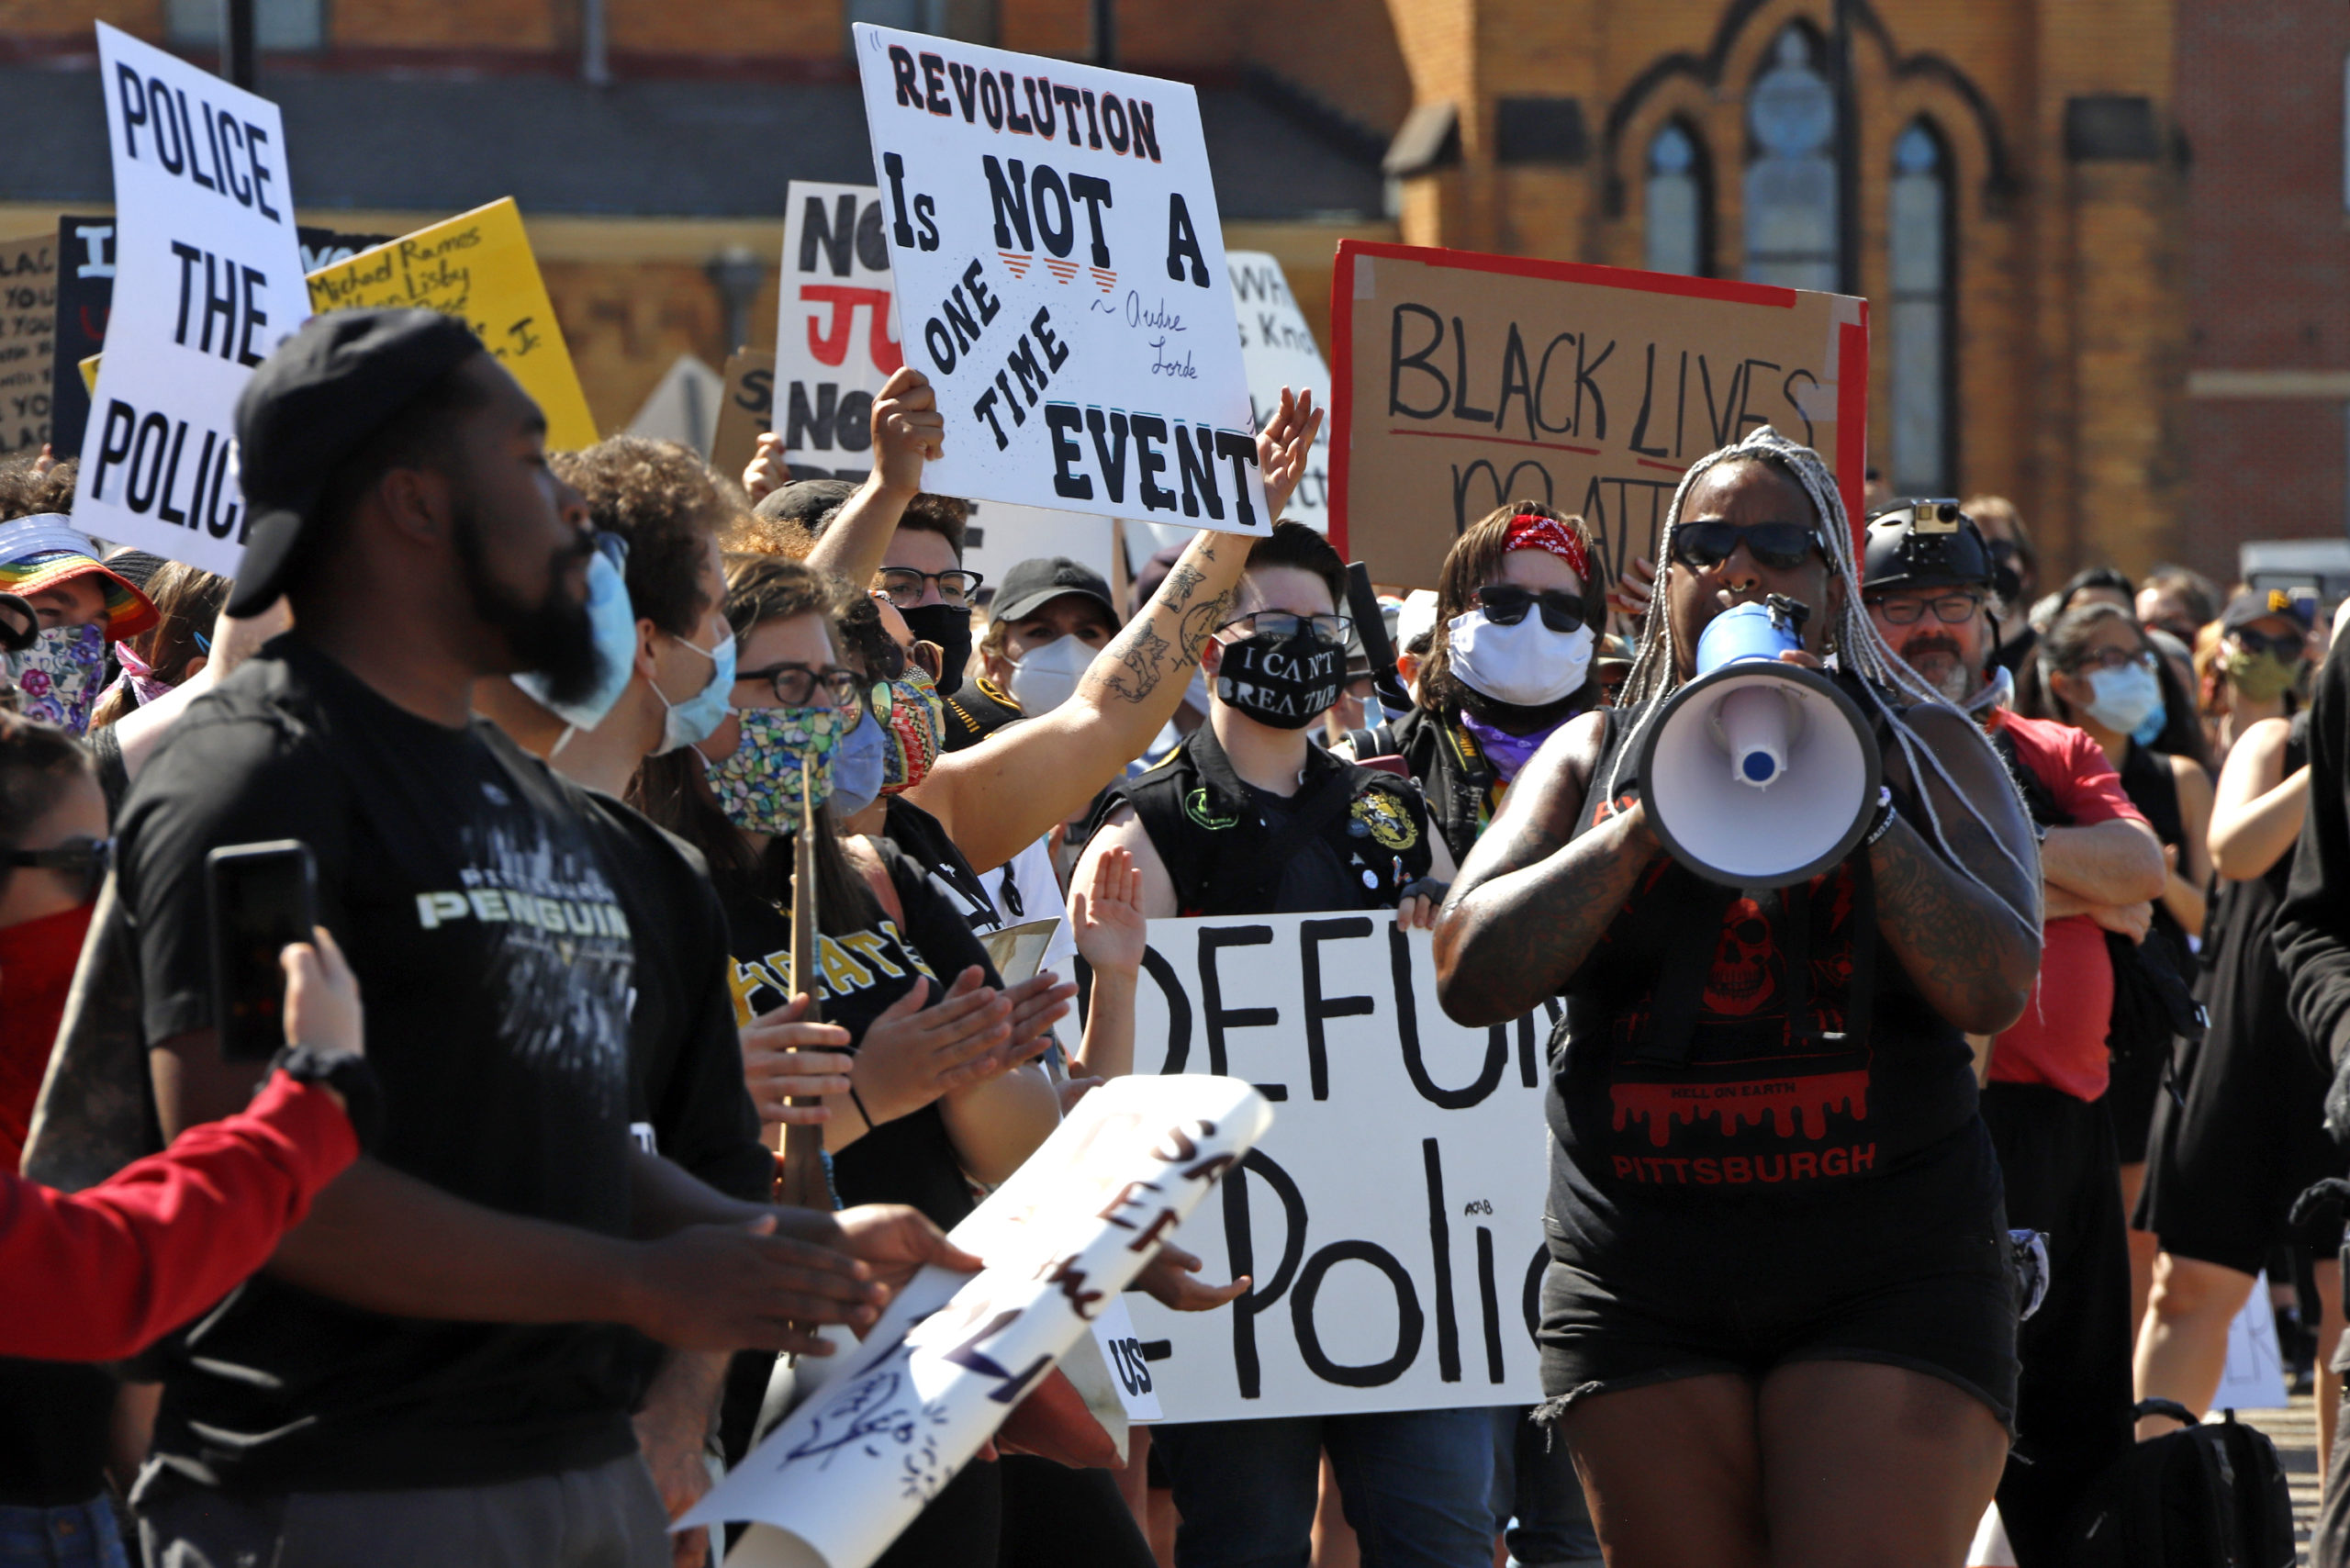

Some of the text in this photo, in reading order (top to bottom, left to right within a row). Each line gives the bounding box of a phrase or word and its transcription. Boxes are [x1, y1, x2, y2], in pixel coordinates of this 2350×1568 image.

[116, 61, 281, 224] POLICE
[889, 44, 1162, 163] REVOLUTION
[982, 154, 1113, 268] NOT
[1167, 193, 1211, 288] A
[171, 241, 267, 369] THE
[924, 259, 1001, 375] ONE
[1126, 290, 1187, 331] Audre
[1148, 335, 1198, 379] Lorde
[974, 306, 1069, 452] TIME
[1388, 302, 1617, 440] BLACK
[92, 398, 248, 547] POLIC
[1045, 402, 1259, 526] EVENT
[1243, 646, 1335, 682] I CAN'T
[1671, 1082, 1796, 1100] HELL ON EARTH
[1610, 1142, 1877, 1185] PITTSBURGH
[1107, 1337, 1153, 1397] US
